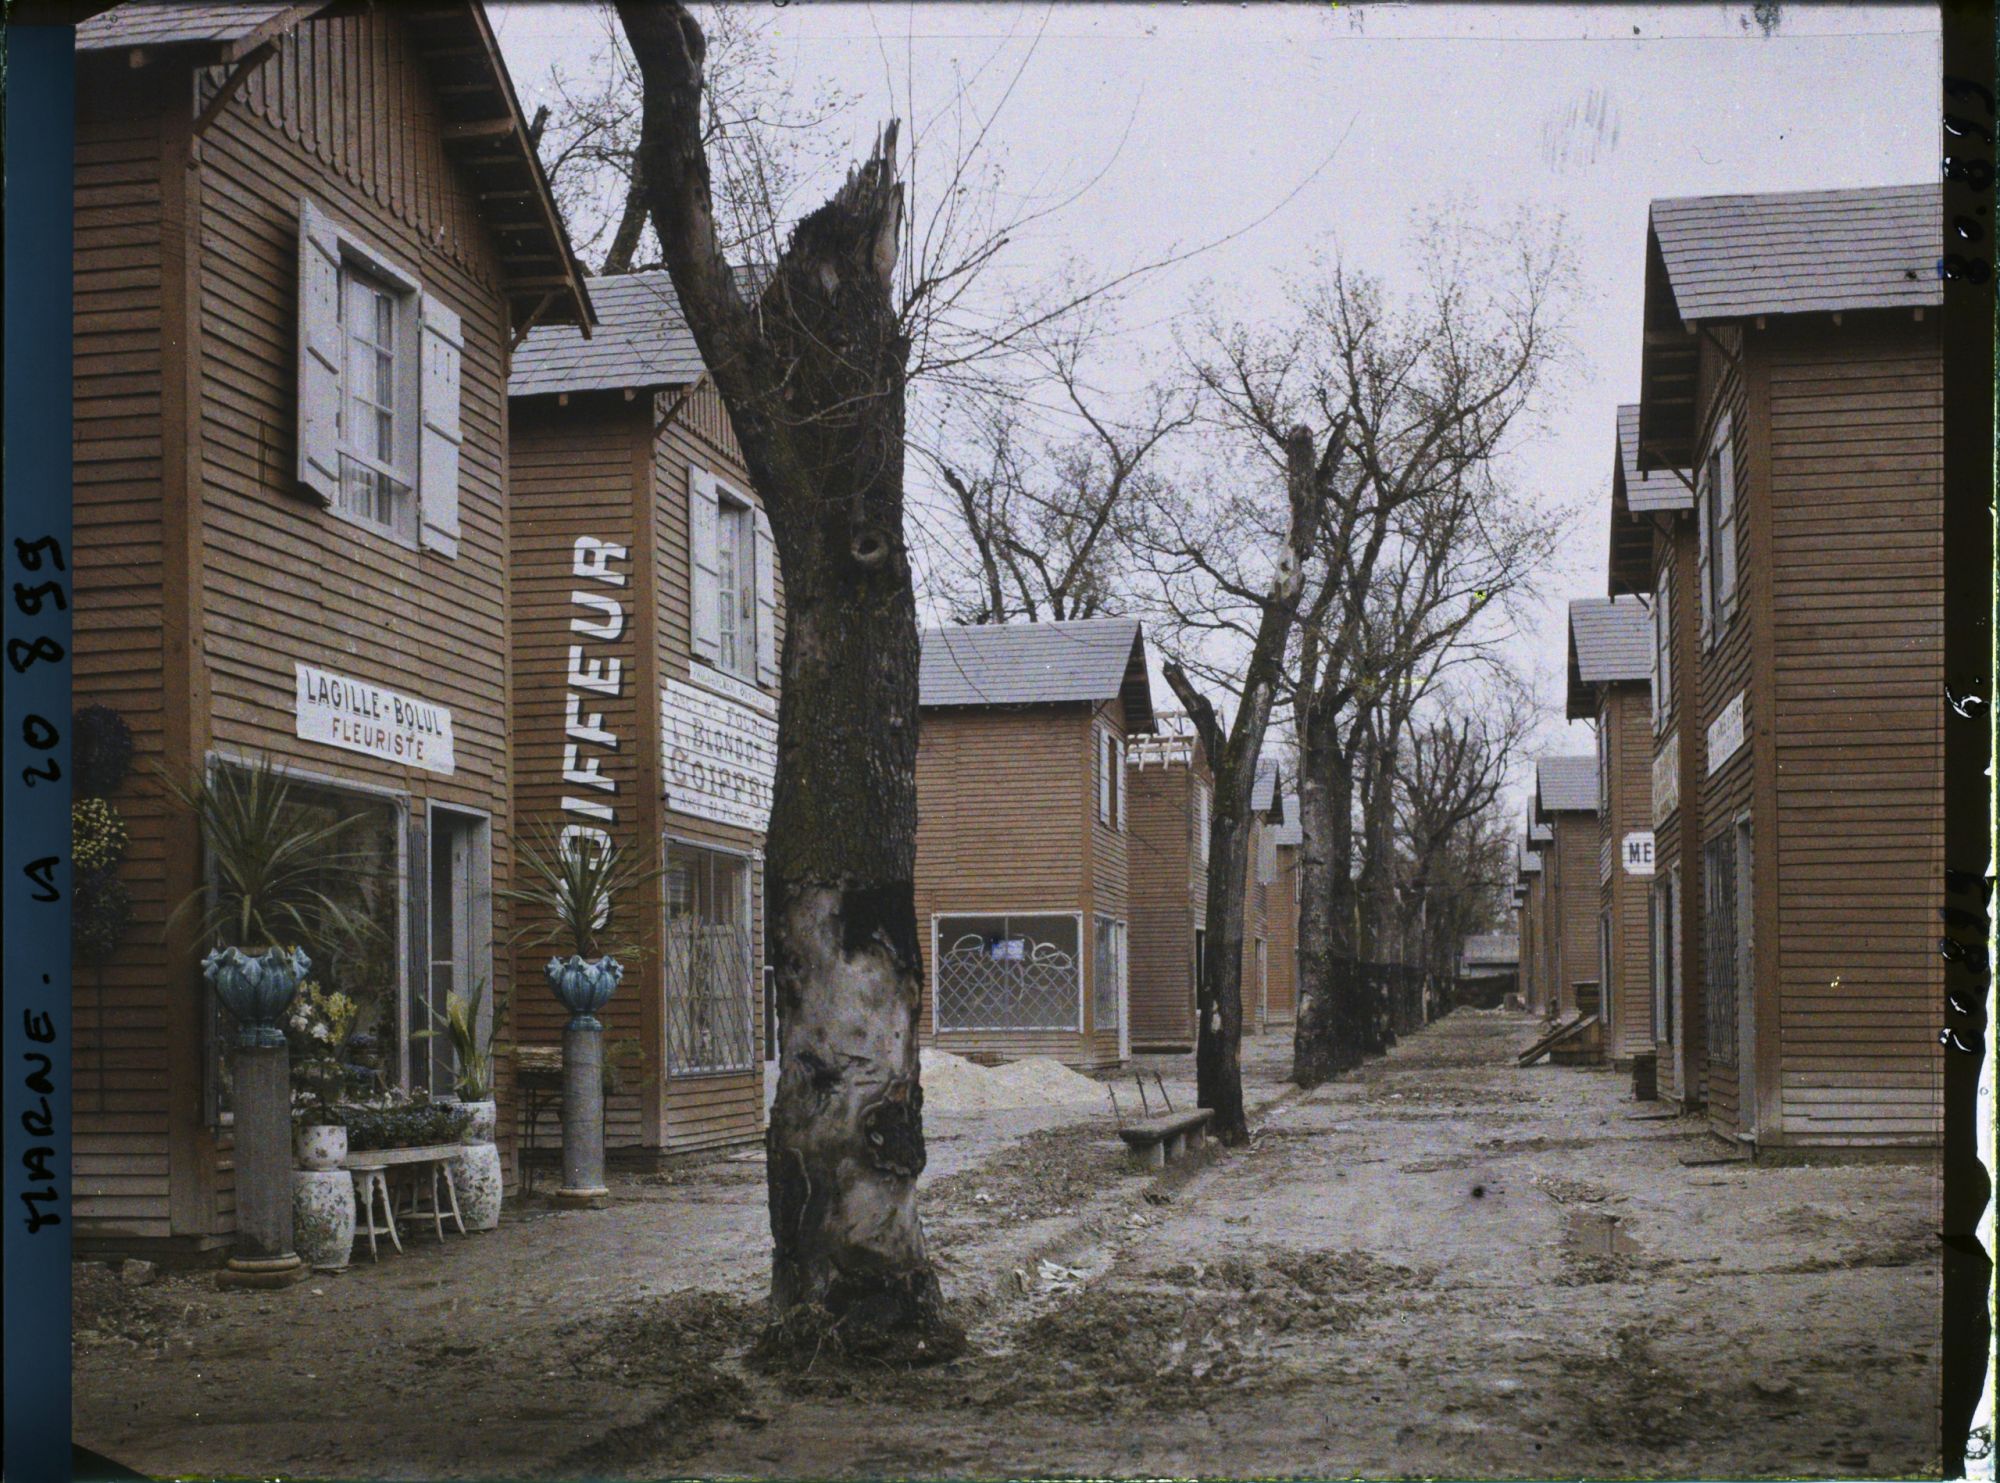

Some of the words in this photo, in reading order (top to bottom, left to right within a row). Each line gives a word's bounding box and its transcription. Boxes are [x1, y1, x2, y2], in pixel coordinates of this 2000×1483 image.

[8, 536, 67, 673] 899
[306, 669, 380, 718] LAGILLE
[23, 715, 61, 786] 20
[332, 717, 424, 760] FLEURISTE
[1629, 842, 1653, 864] ME
